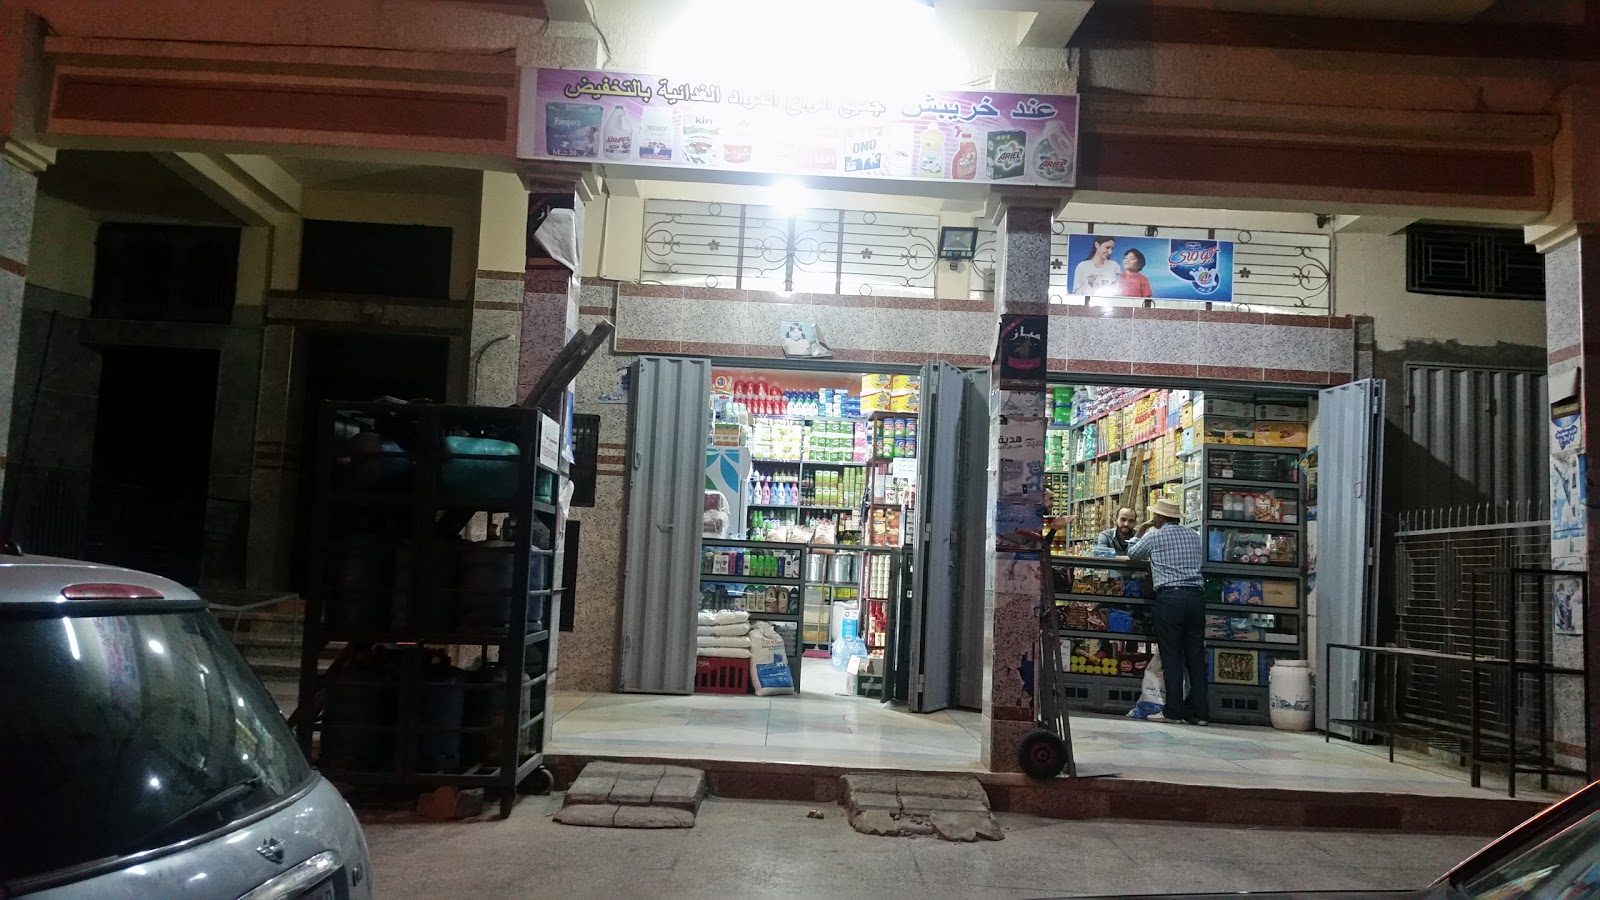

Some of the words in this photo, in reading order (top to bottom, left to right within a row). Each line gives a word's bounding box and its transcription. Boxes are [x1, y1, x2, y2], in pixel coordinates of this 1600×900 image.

[564, 76, 652, 103] بالتخفيض
[1011, 98, 1057, 120] عند
[695, 115, 713, 124] kiri
[853, 139, 877, 153] OMO
[999, 151, 1021, 160] ARIEL
[1040, 160, 1066, 168] ARIEL
